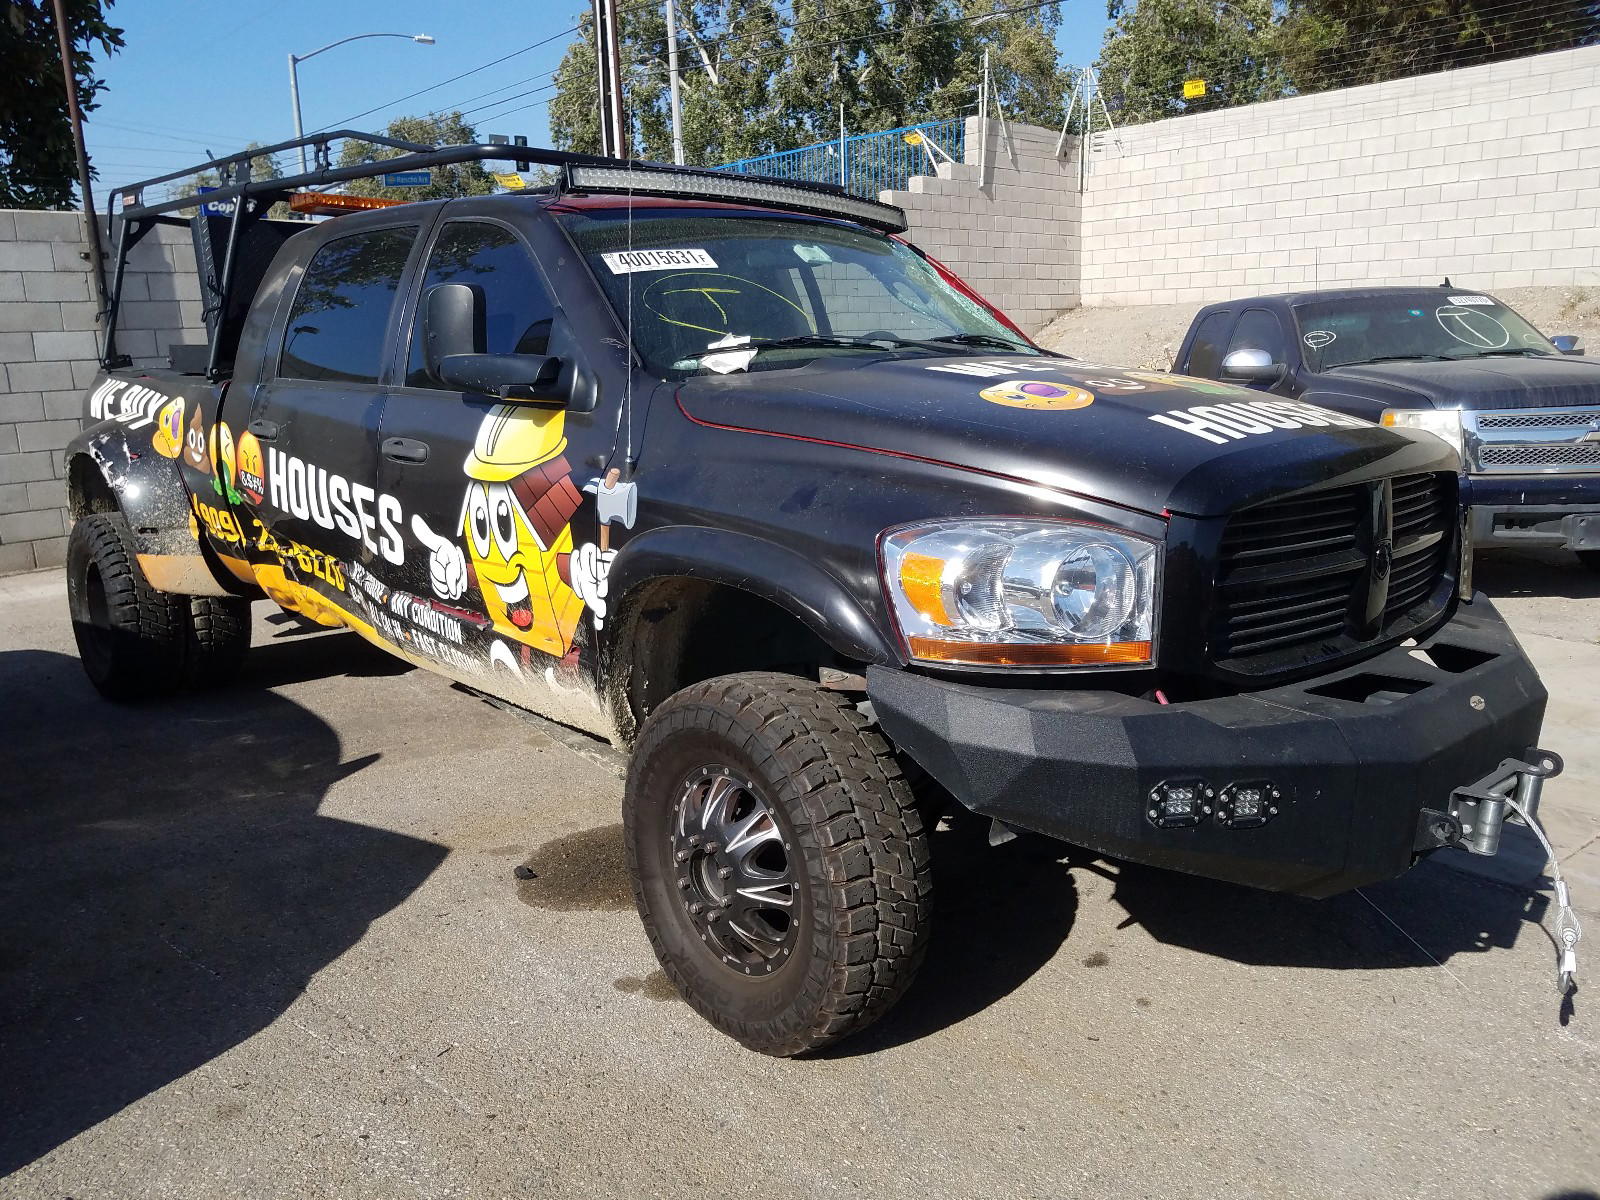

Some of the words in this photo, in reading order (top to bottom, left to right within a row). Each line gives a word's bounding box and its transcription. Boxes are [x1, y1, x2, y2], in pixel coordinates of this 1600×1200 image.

[207, 200, 258, 213] Copt
[618, 250, 699, 268] 40015631
[90, 378, 128, 421] WE
[119, 384, 169, 430] BUY
[1147, 401, 1376, 444] HOUSES
[268, 447, 406, 566] HOUSES
[411, 602, 463, 645] CONDITION
[411, 628, 440, 657] FAST
